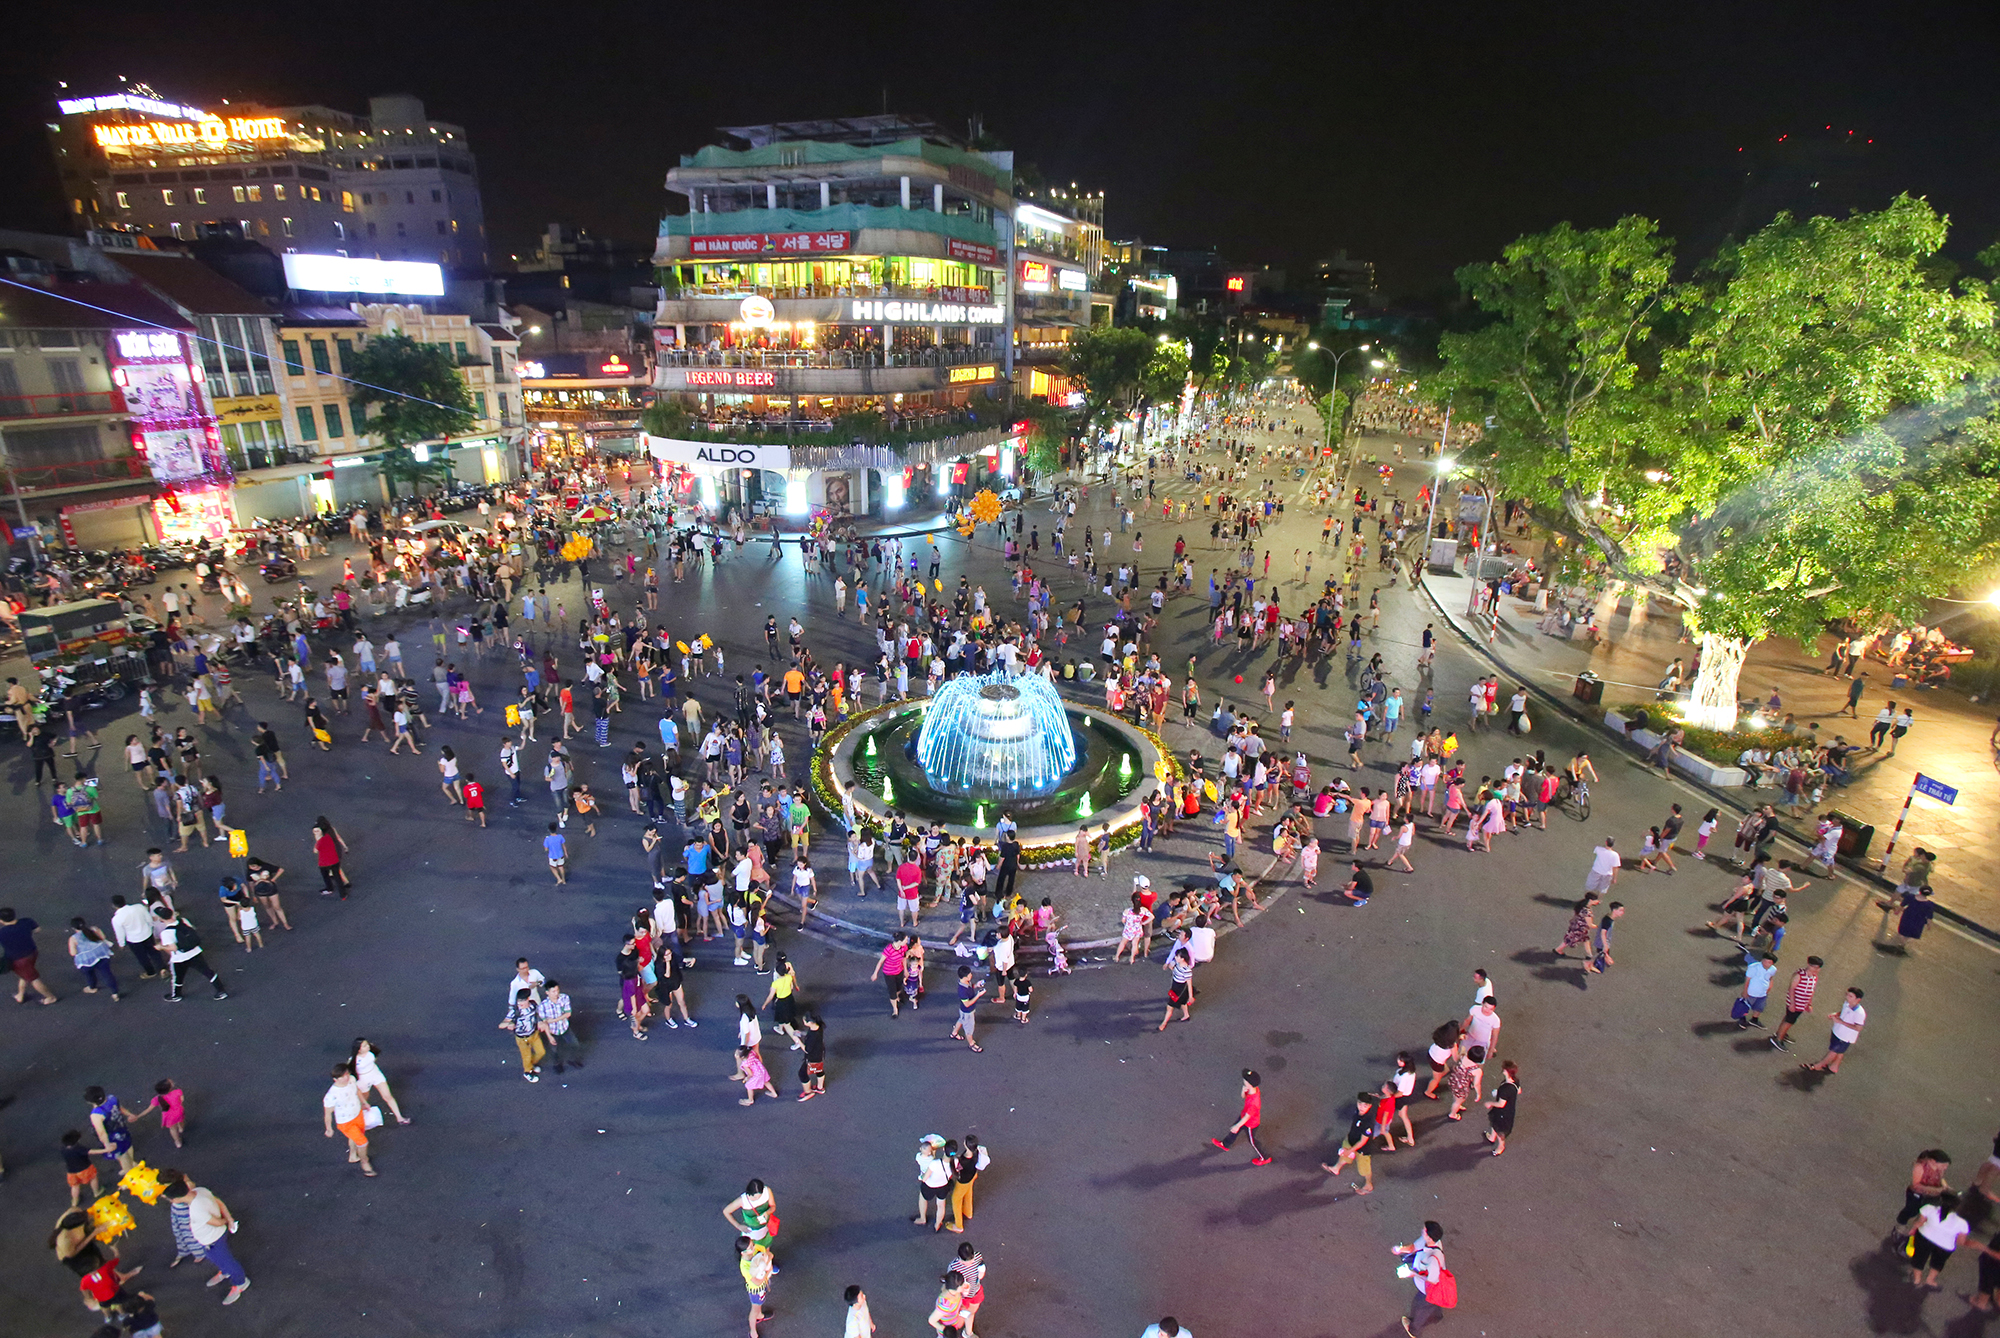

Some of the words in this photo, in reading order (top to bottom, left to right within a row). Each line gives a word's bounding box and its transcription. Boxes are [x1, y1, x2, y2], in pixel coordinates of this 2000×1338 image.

[150, 122, 196, 144] VILLE
[229, 117, 291, 141] HOTEL
[694, 239, 707, 251] MÌ
[708, 238, 730, 251] HÀN
[731, 237, 758, 251] QUỐC
[782, 234, 811, 250] 서울
[816, 233, 846, 249] 식당
[852, 300, 966, 323] HIGHLANDS
[685, 371, 733, 385] LEGEND
[735, 371, 775, 386] BEER
[696, 447, 756, 464] ALDO
[1928, 787, 1943, 798] THÁI
